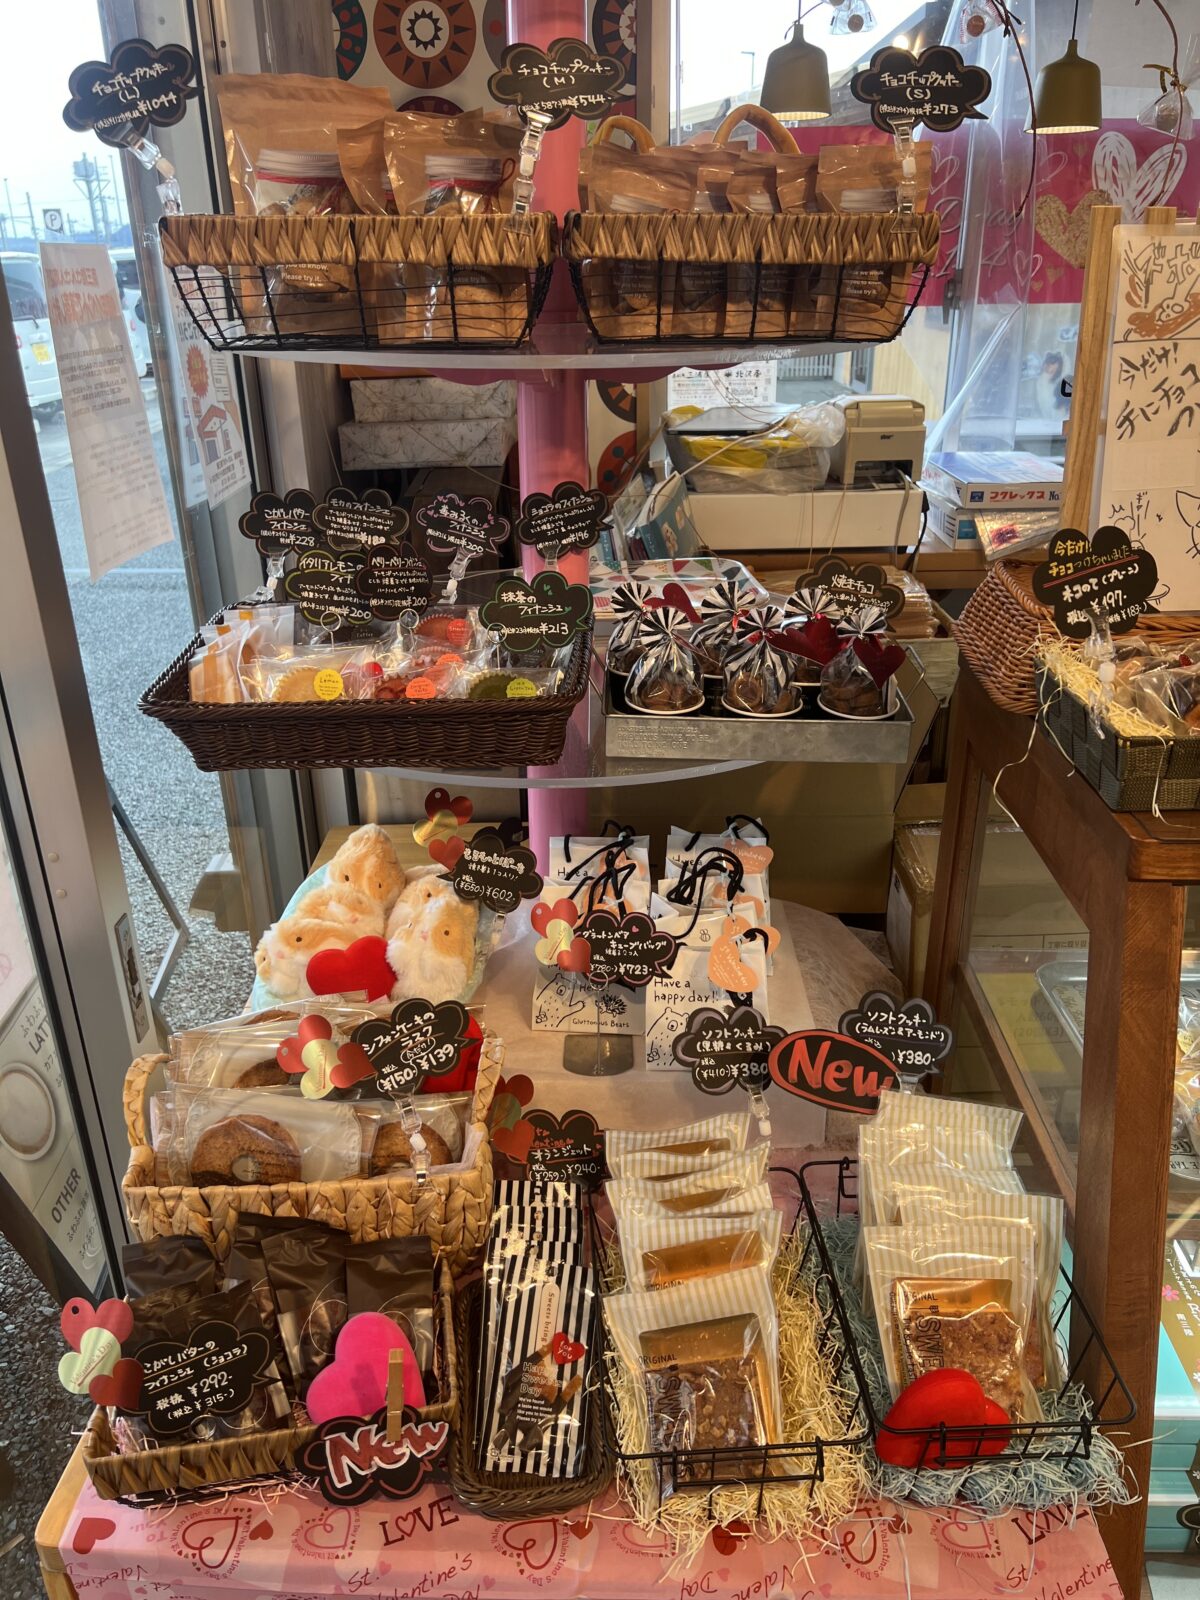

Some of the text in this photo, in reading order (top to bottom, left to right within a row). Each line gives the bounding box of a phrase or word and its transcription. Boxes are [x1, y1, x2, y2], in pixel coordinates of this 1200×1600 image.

[518, 59, 611, 76] チョコチップクッキー
[880, 71, 960, 87] チョコチップクッキー
[119, 86, 140, 103] (L)
[906, 88, 931, 101] (S)
[281, 271, 302, 281] Please
[304, 274, 313, 282] try
[501, 591, 537, 604] 抹茶の
[1062, 578, 1098, 602] ネコのて
[654, 978, 691, 989] Have a
[654, 989, 686, 1004] happy
[610, 1019, 630, 1028] Bears
[868, 1010, 927, 1025] ソフトクッキー
[362, 1011, 435, 1055] シフォンケーキの
[400, 1026, 433, 1048] ラスク
[701, 1028, 762, 1040] ソフトクッキー
[788, 1039, 894, 1097] New
[531, 1144, 591, 1162] オランジェット
[51, 1168, 82, 1224] OTHER
[144, 1340, 216, 1374] こがしバターの
[203, 1344, 248, 1368] (ショコラ)
[520, 1384, 542, 1398] Day
[155, 1392, 185, 1411] 税抜
[325, 1421, 449, 1488] New
[348, 1567, 380, 1594] St.
